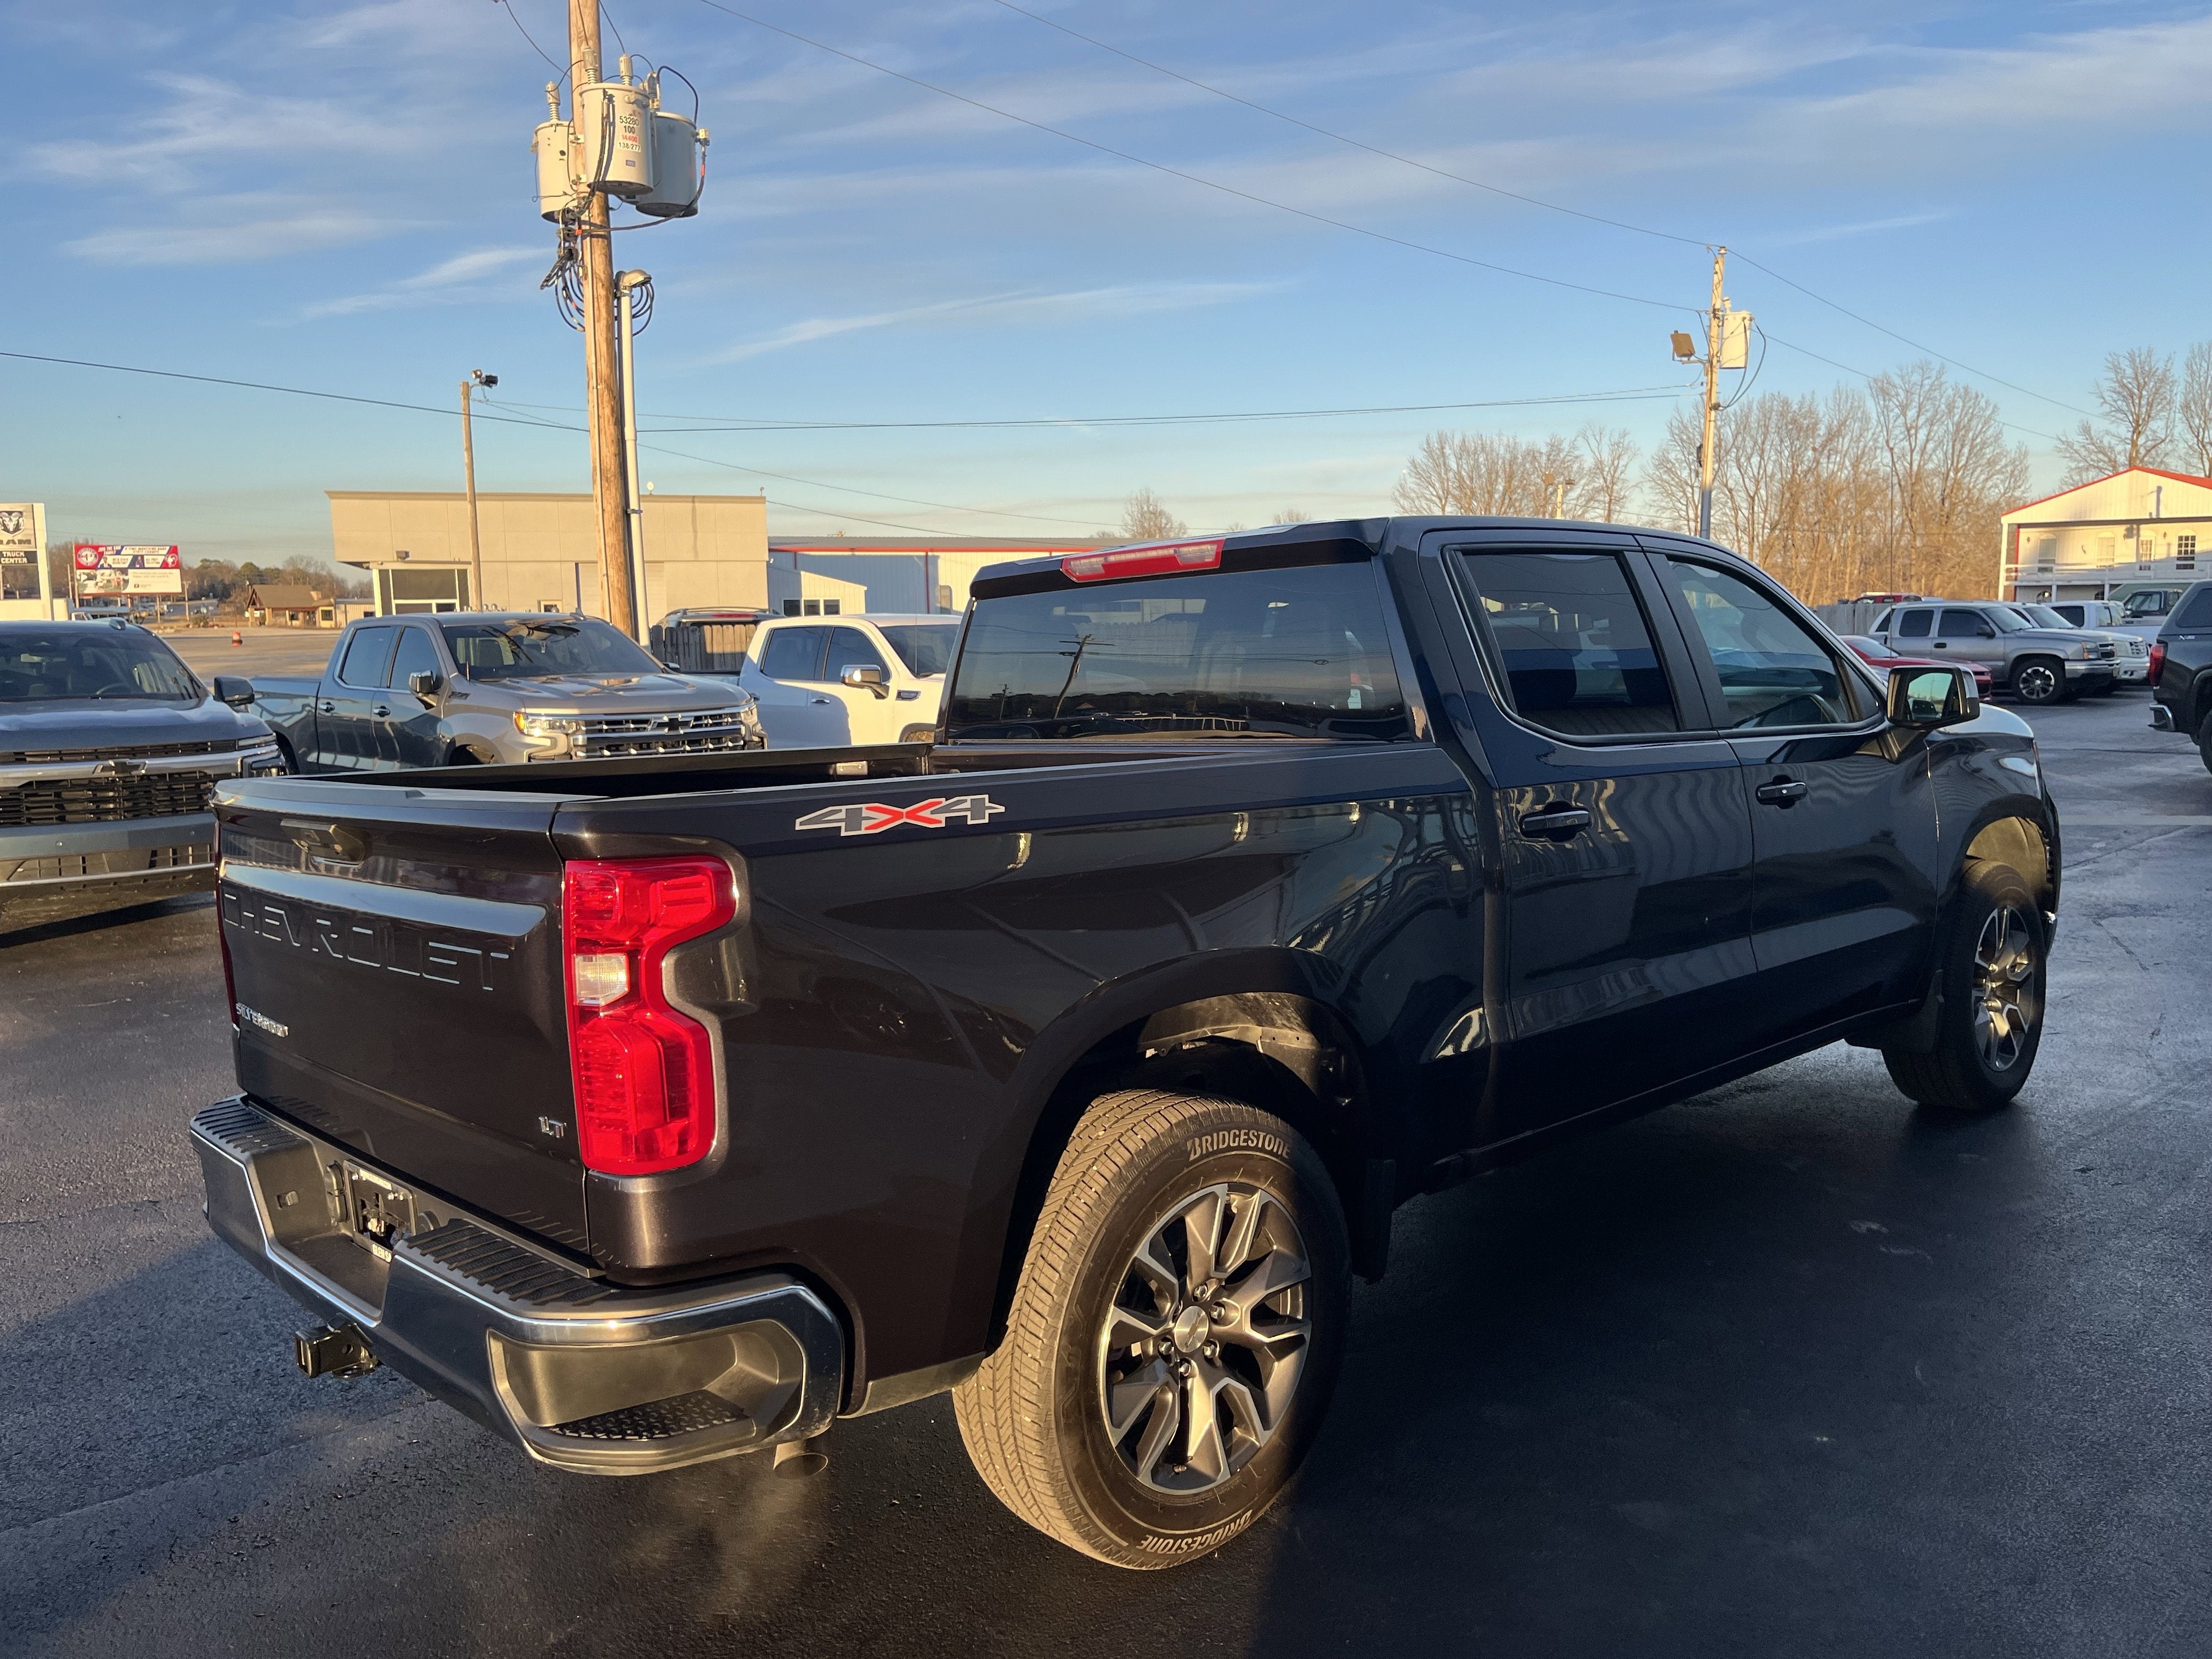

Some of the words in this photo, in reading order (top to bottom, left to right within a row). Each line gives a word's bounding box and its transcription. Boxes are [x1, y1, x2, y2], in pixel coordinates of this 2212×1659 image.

[619, 116, 639, 126] 53280
[624, 125, 635, 134] 100
[223, 893, 510, 991] CHEVROLET
[538, 1116, 567, 1138] LT
[1186, 1128, 1291, 1162] BRIDGESTONE
[1136, 1509, 1253, 1555] BRIDGESTONE
